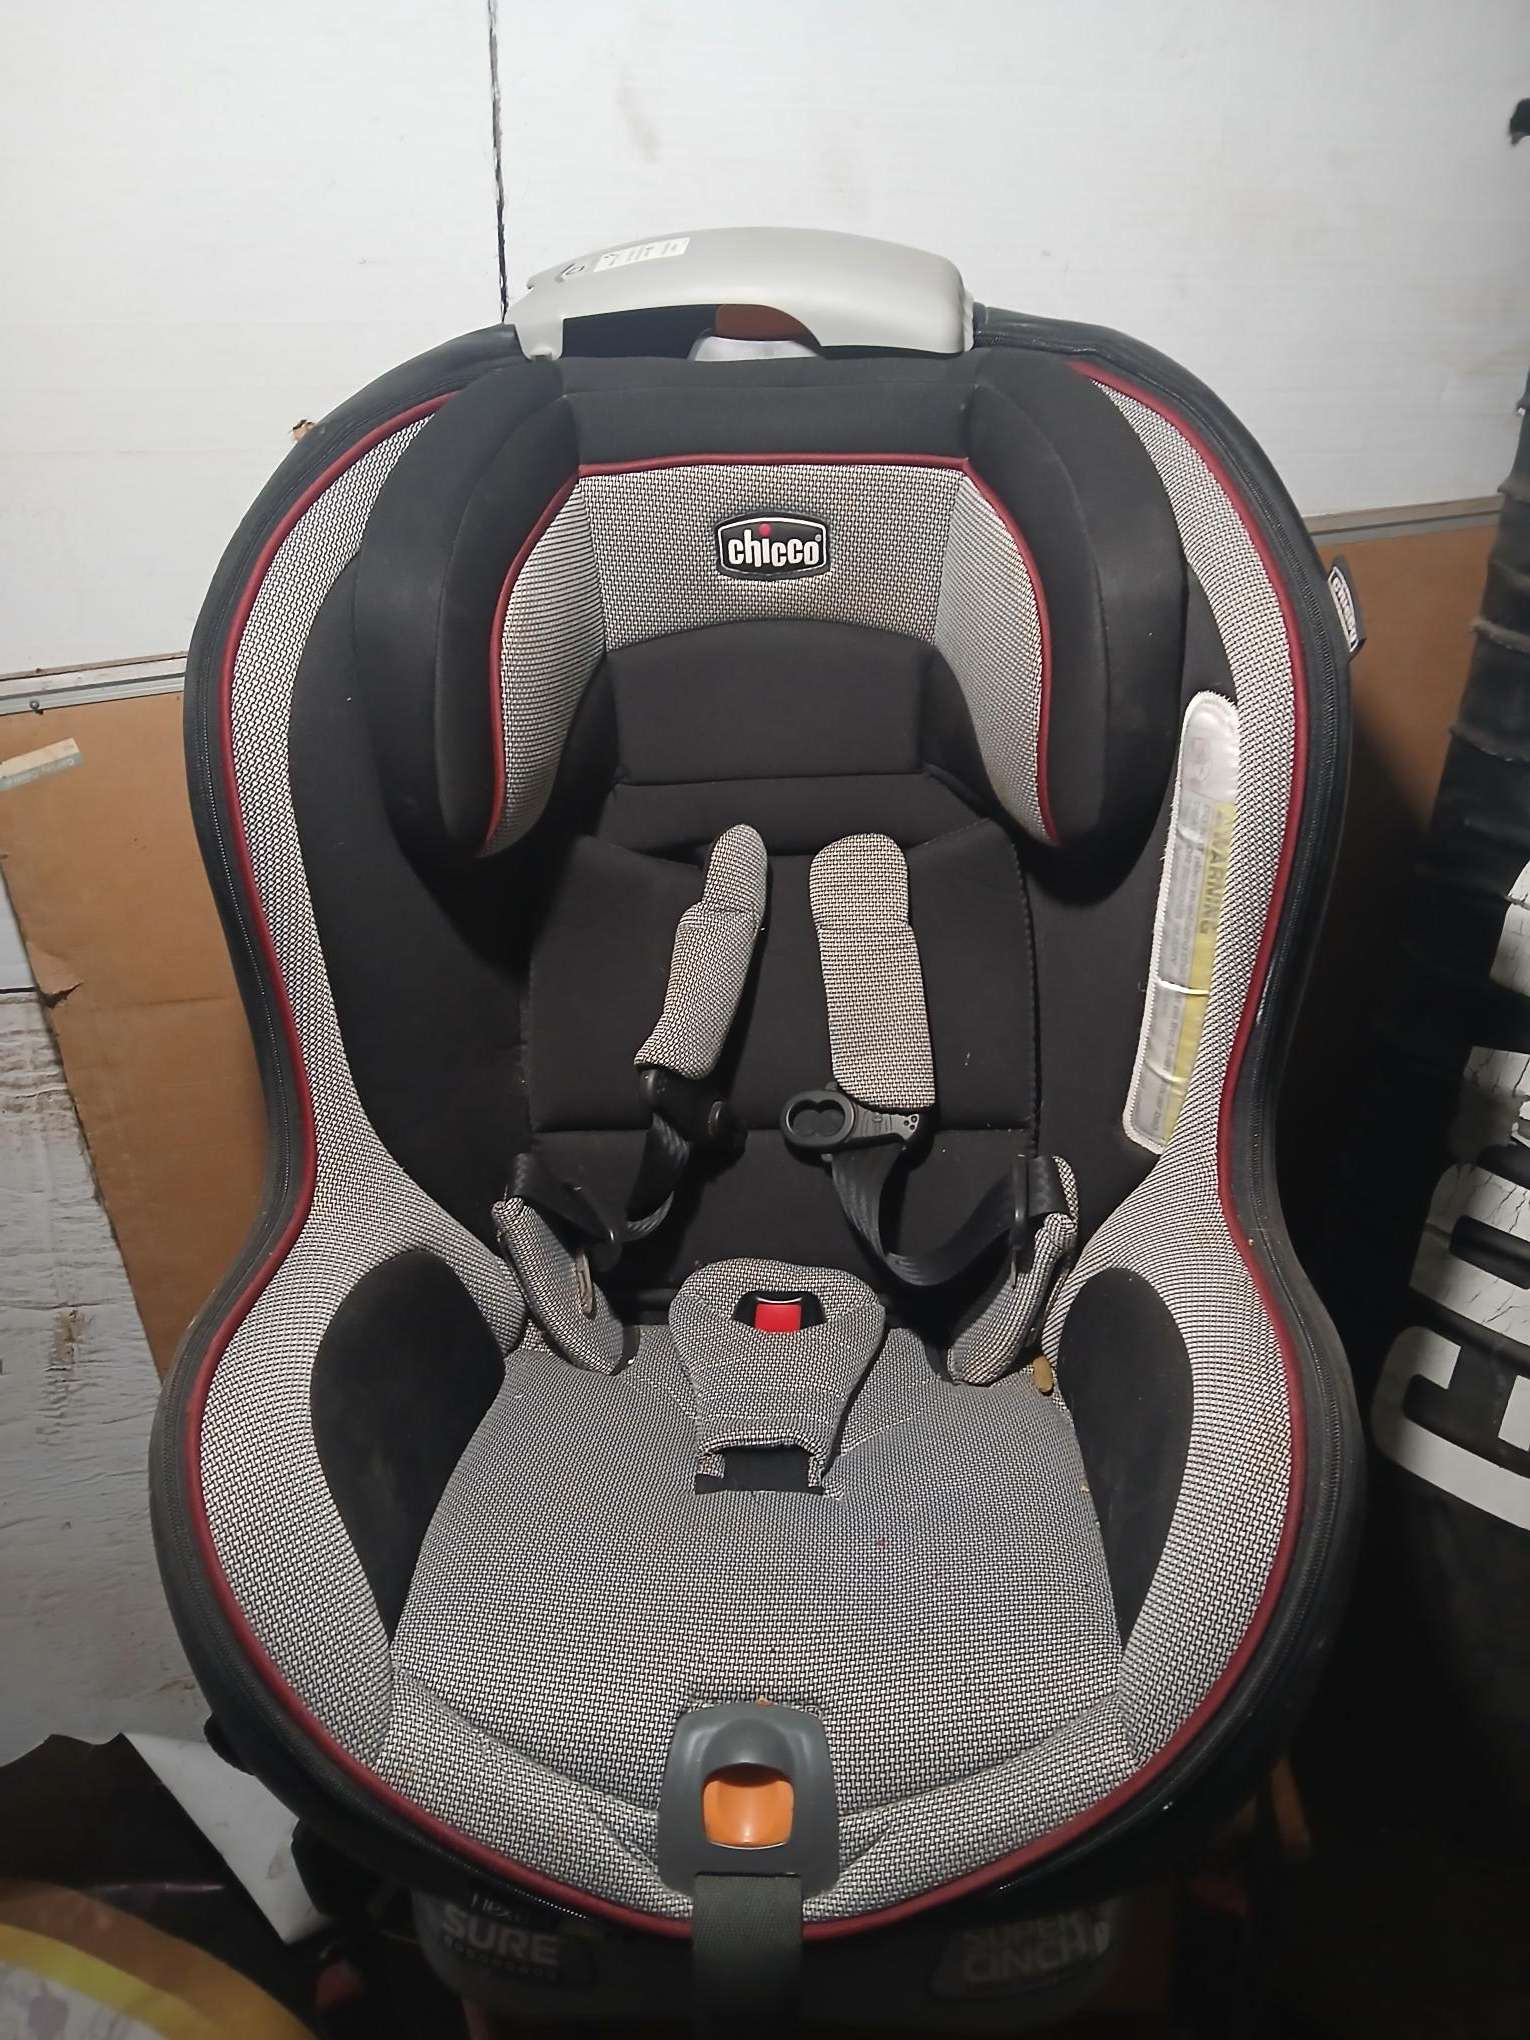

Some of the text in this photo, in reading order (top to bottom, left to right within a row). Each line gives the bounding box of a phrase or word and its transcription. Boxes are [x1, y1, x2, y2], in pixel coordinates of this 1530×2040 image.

[728, 523, 820, 567] chicco
[1200, 831, 1228, 935] WARNING
[445, 1903, 560, 1967] SURE
